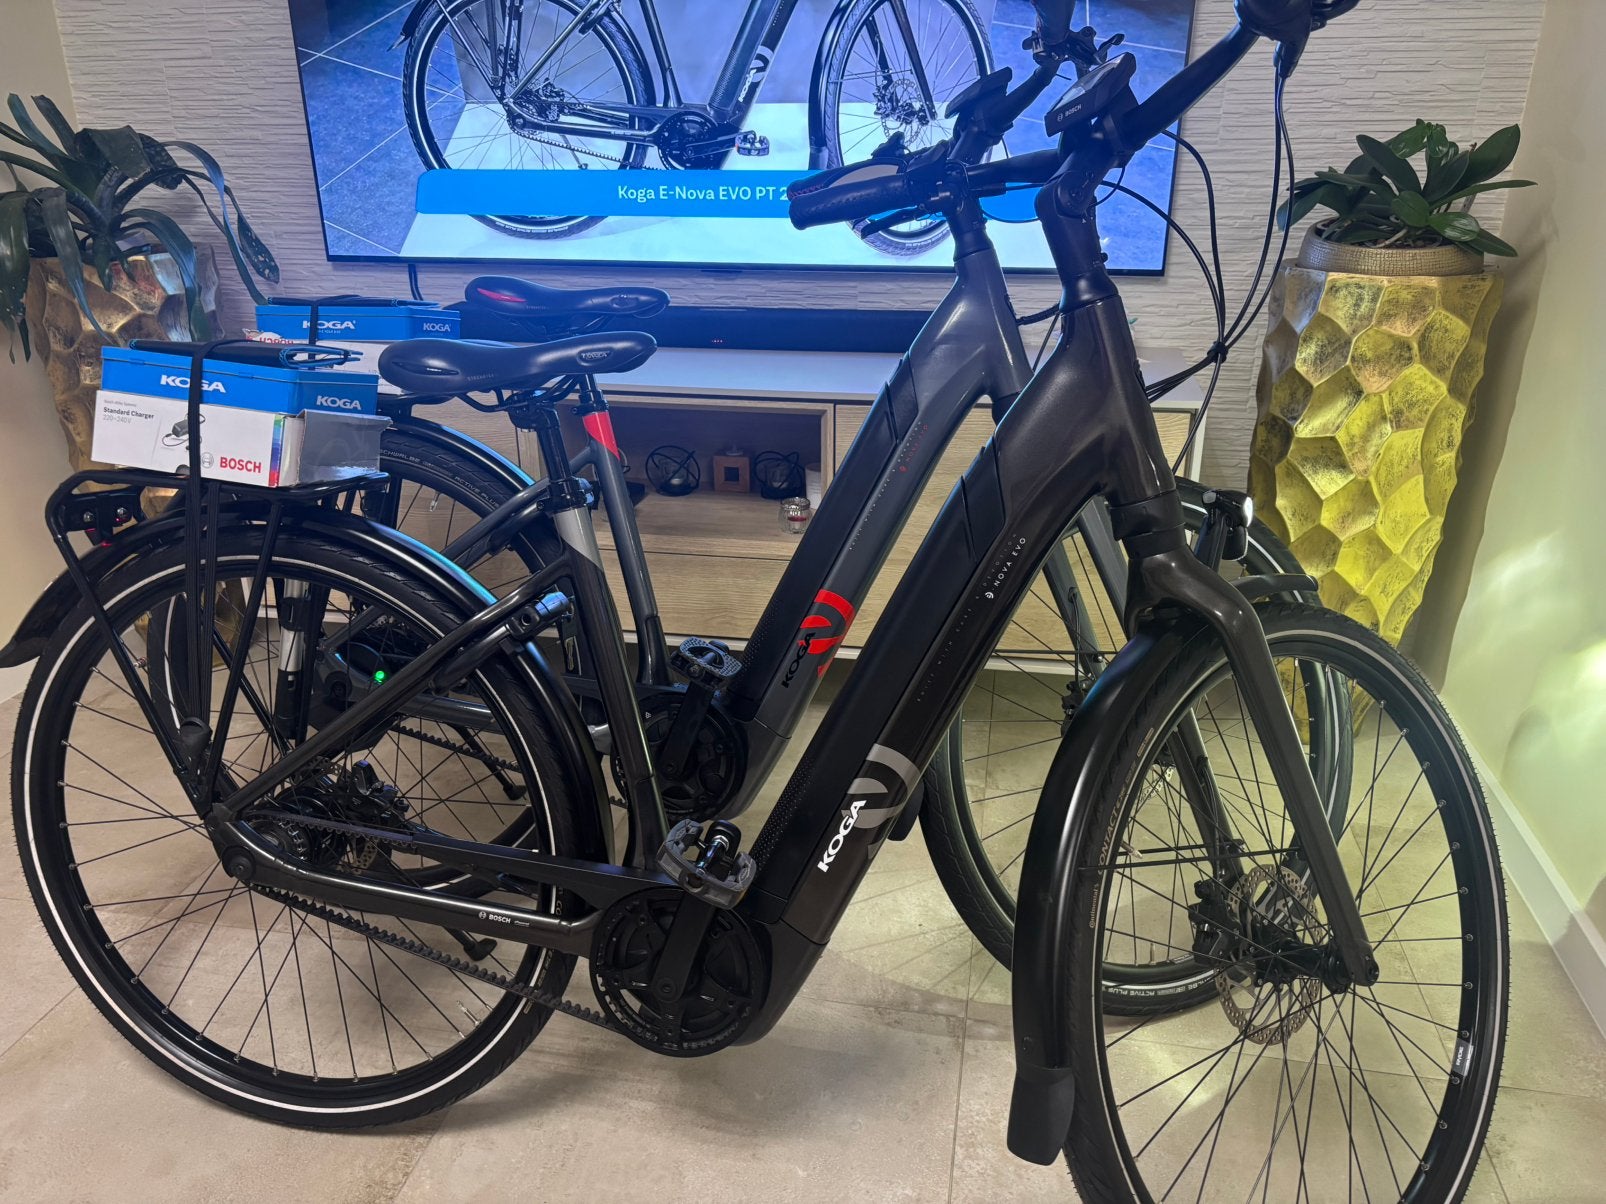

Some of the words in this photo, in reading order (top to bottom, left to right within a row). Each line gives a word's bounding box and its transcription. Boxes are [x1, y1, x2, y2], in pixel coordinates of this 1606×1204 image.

[1064, 104, 1082, 117] BOSCH
[618, 185, 655, 203] Koga
[659, 185, 715, 200] E-Nova
[719, 186, 752, 200] EVO
[756, 186, 776, 201] PT
[423, 322, 451, 332] KOGA
[316, 395, 362, 411] KOGA
[103, 406, 130, 416] Standard
[130, 410, 155, 419] Charger
[219, 456, 262, 474] BOSCH
[993, 560, 1013, 588] NOVA
[1012, 537, 1026, 557] EVO
[781, 632, 816, 689] KOGA
[816, 799, 867, 873] KOGA
[488, 913, 511, 924] BOSCH
